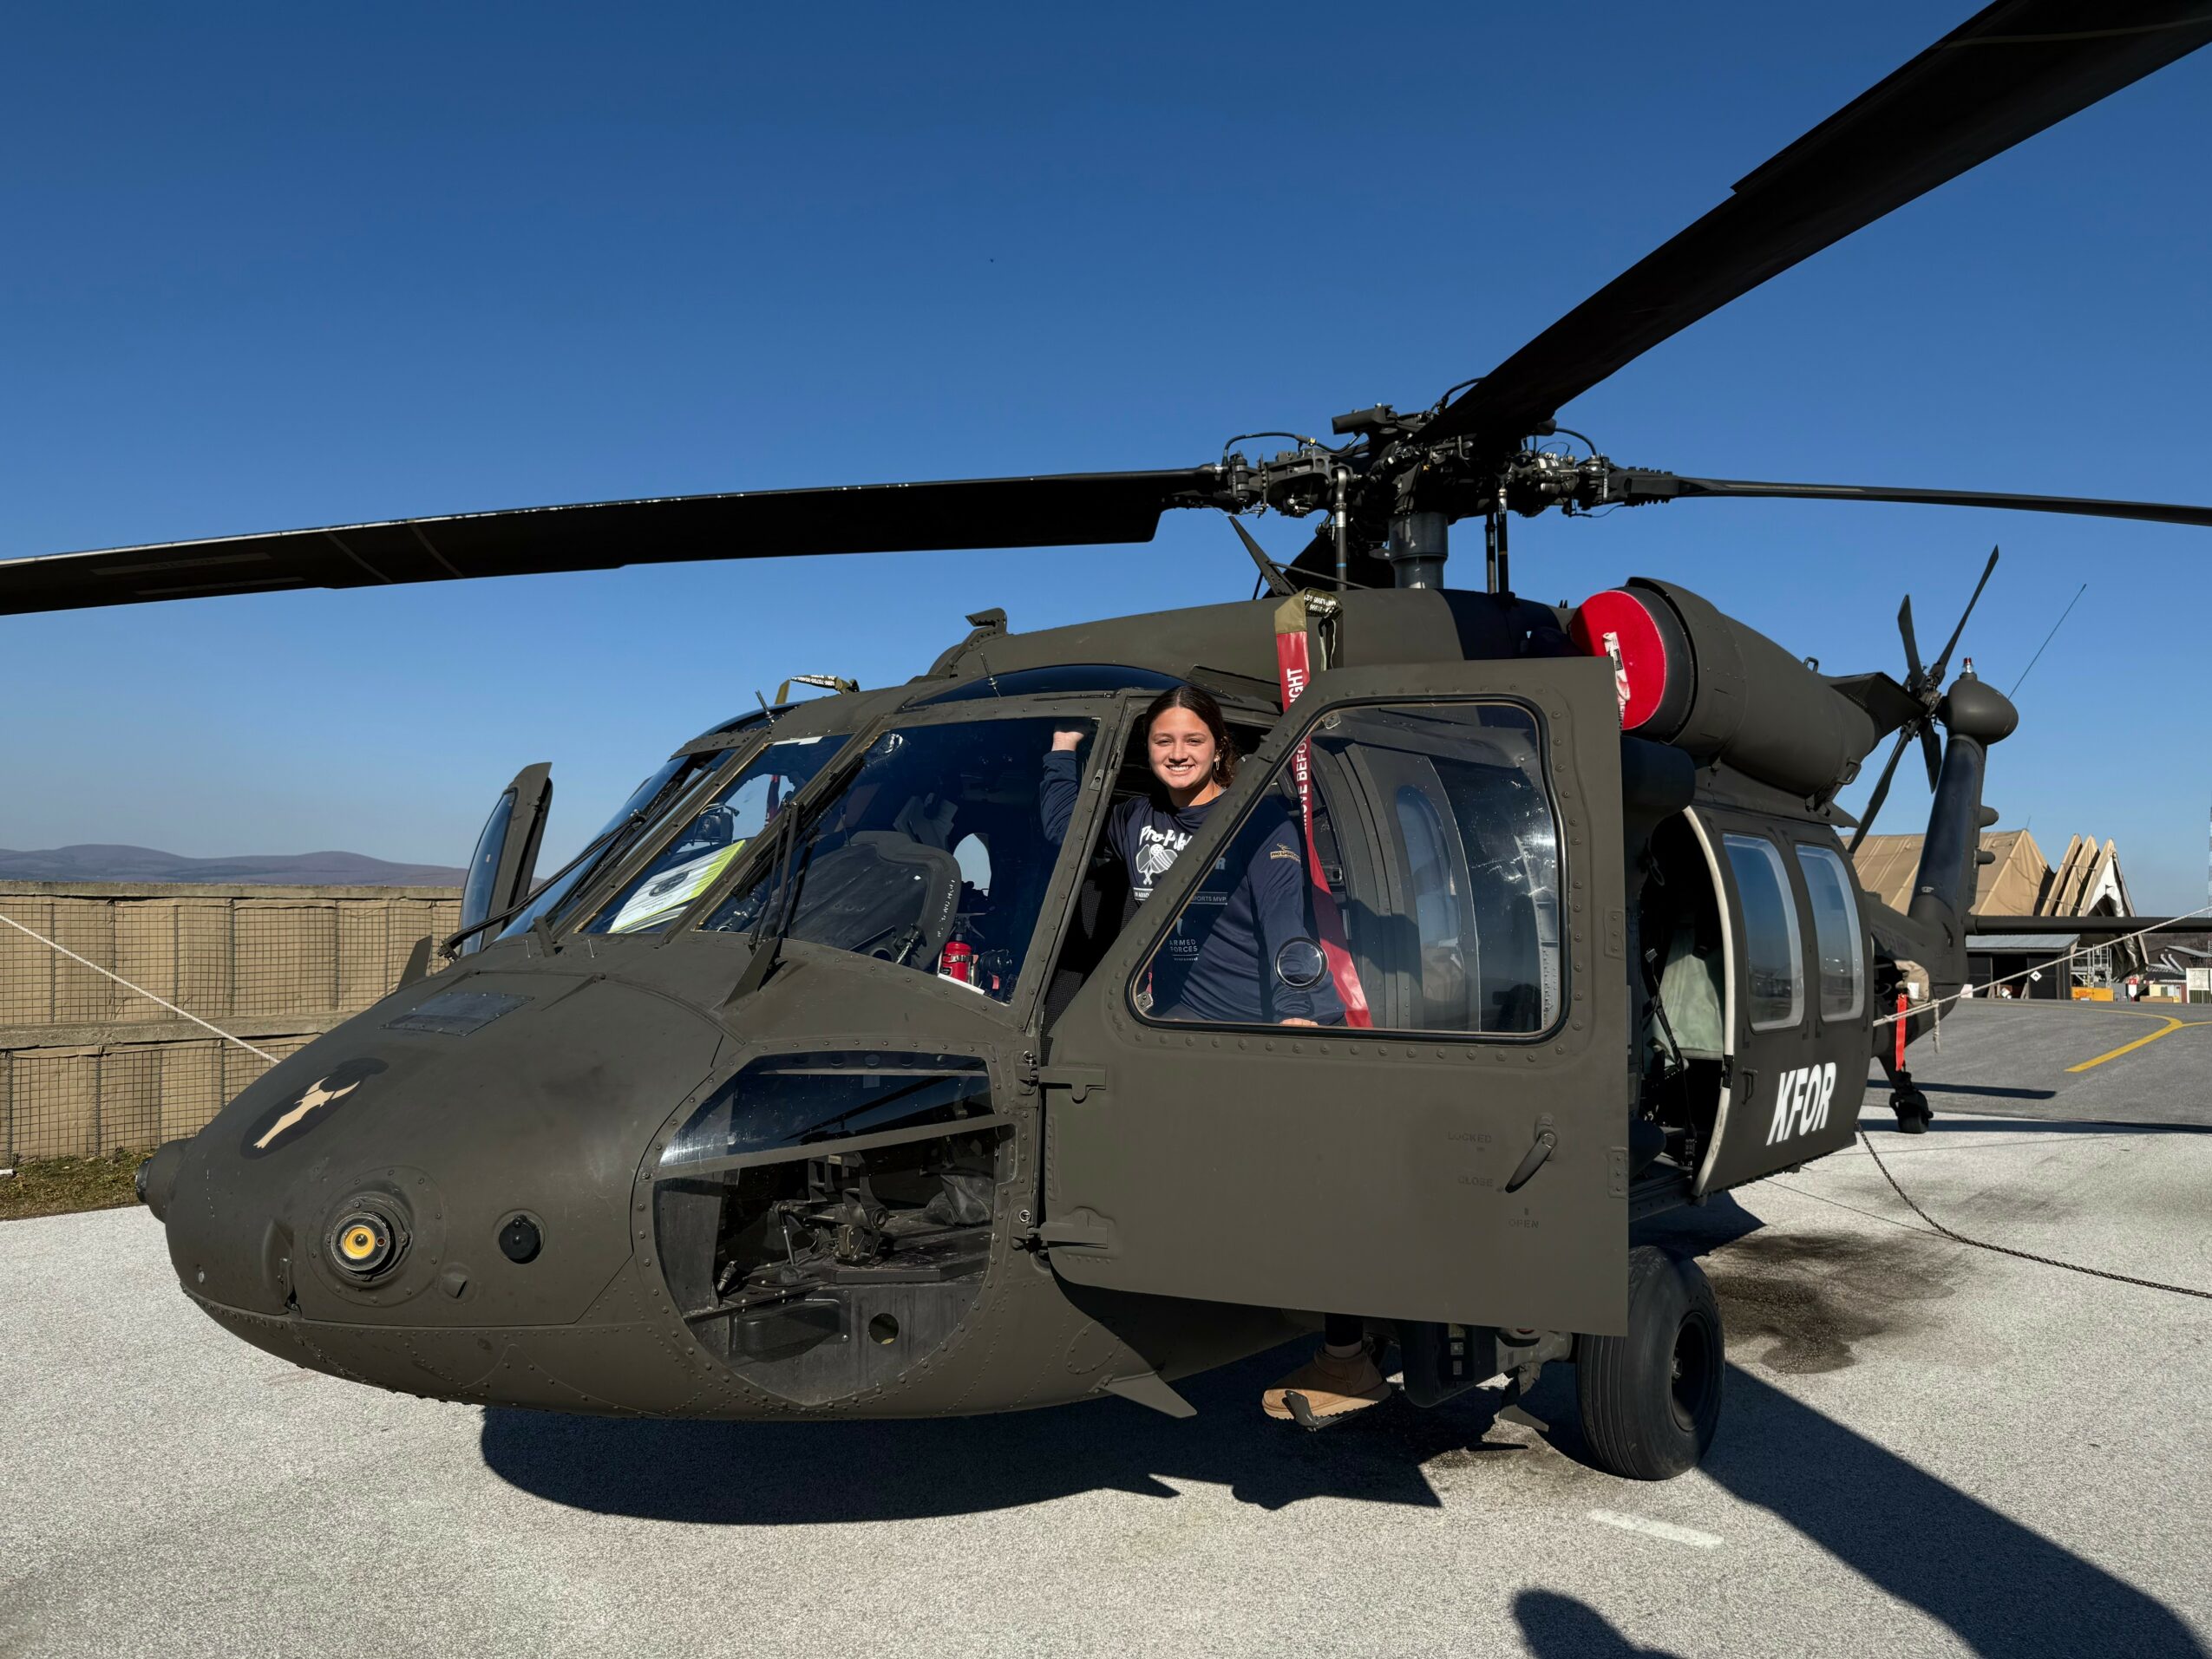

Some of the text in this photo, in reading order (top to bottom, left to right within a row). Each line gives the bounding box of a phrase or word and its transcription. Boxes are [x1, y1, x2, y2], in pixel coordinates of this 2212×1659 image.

[1286, 668, 1304, 703] GHT
[1296, 738, 1308, 781] BEFO
[1766, 1061, 1836, 1146] KFOR
[1447, 1131, 1492, 1144] LOCKED
[1508, 1218, 1540, 1229] OPEN
